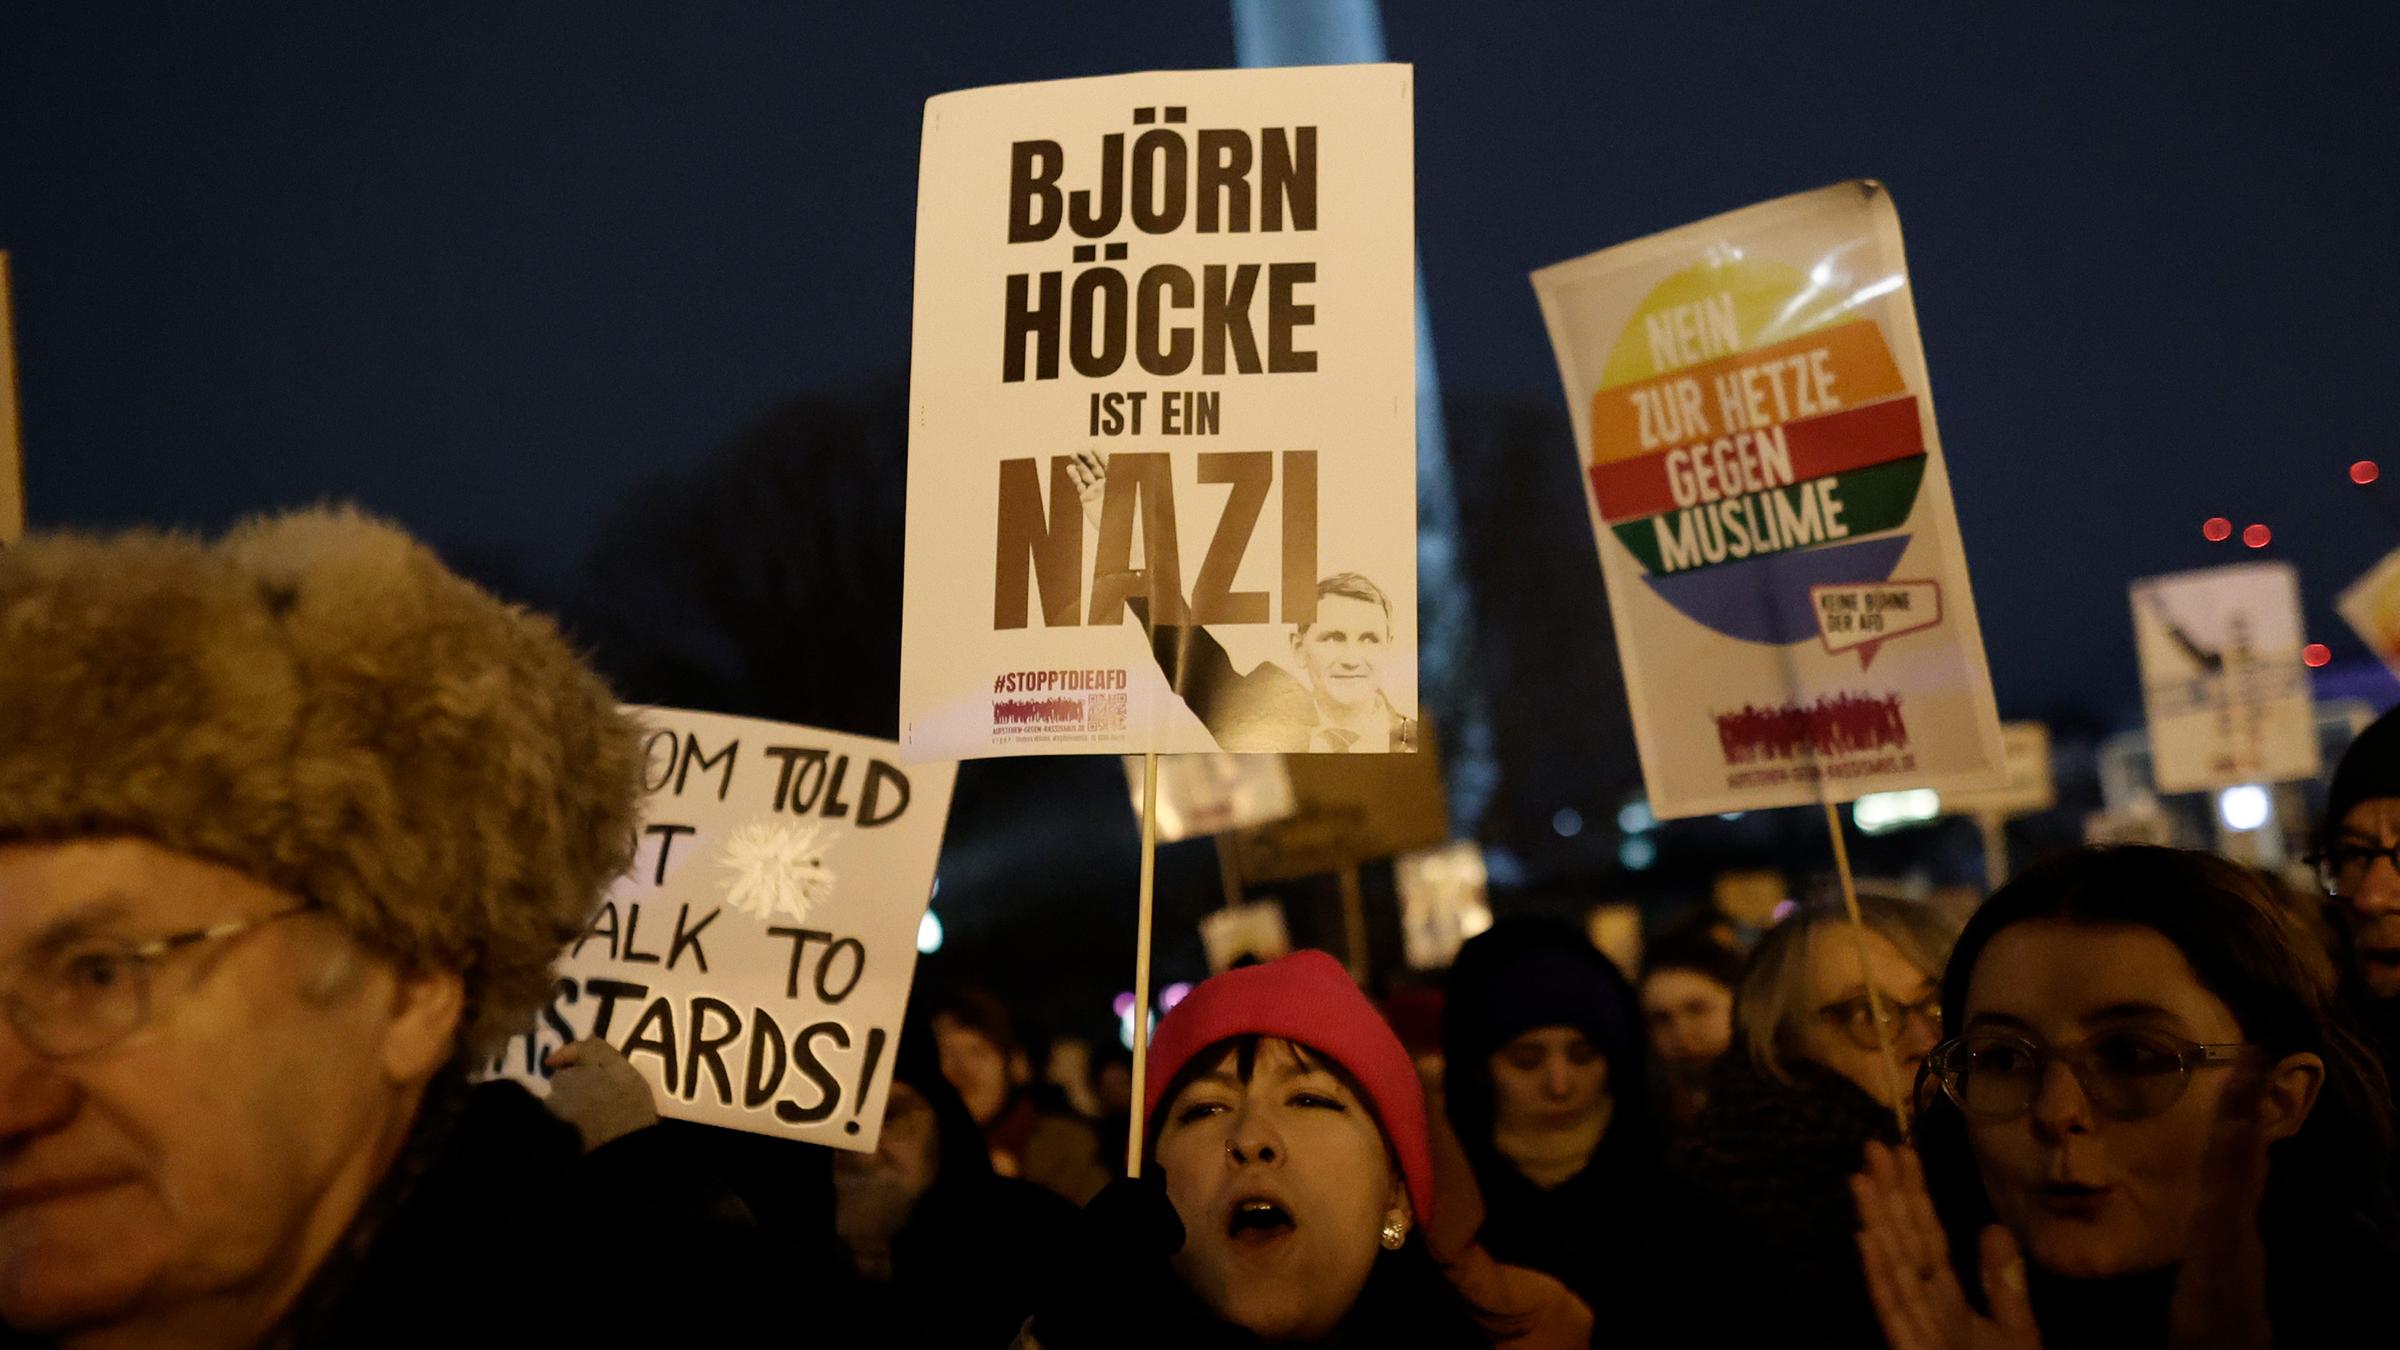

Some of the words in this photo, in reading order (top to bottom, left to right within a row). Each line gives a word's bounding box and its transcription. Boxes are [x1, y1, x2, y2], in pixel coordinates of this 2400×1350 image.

[1008, 106, 1317, 244] BJÖRN
[1002, 242, 1318, 383] HÖCKE
[1645, 291, 1741, 373] NEIN
[1090, 392, 1147, 437] IST
[1161, 391, 1220, 435] EIN
[1630, 377, 1711, 449] ZUR
[1714, 347, 1841, 433] HETZE
[1665, 425, 1795, 510] GEGEN
[994, 450, 1318, 630] NAZI
[1652, 476, 1848, 573] MUSLIME
[994, 669, 1127, 693] #STOPPTDIEAFD
[644, 730, 739, 802] OM
[764, 746, 911, 829] TOLD
[571, 902, 720, 973] ALK
[767, 927, 866, 1004] TO
[494, 977, 887, 1137] STARDS!
